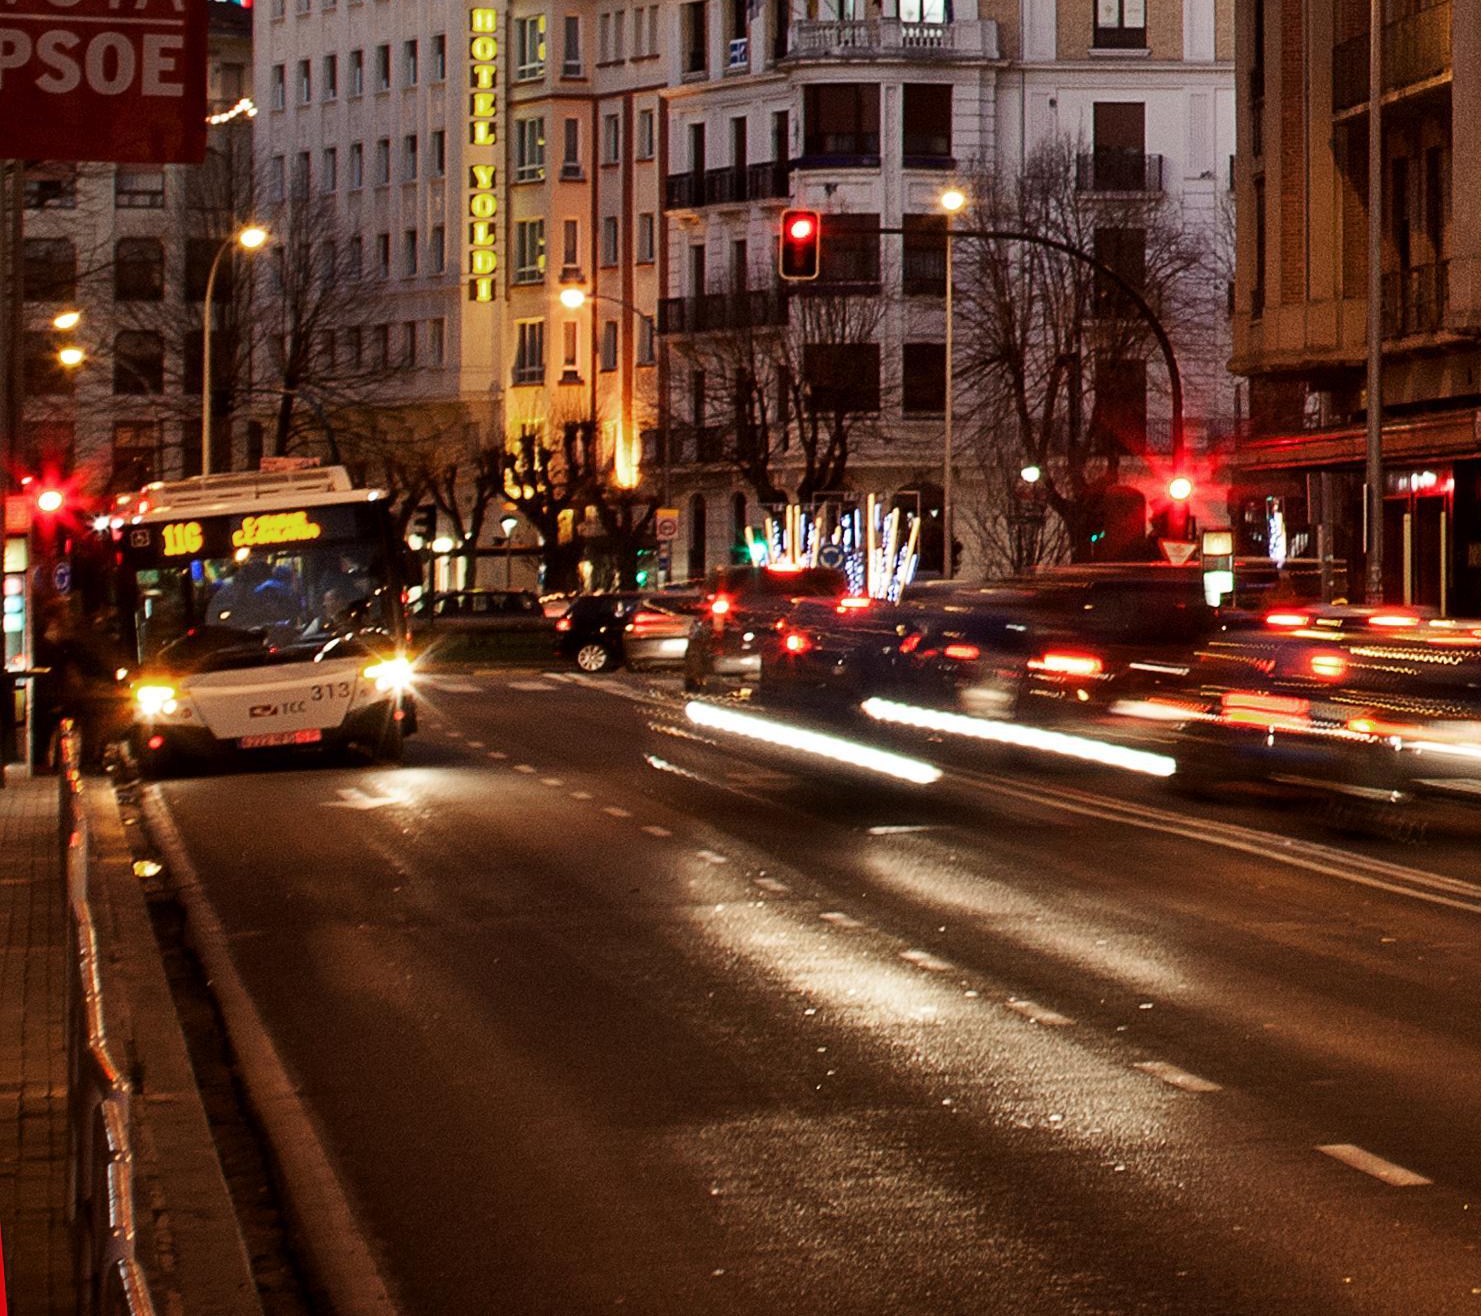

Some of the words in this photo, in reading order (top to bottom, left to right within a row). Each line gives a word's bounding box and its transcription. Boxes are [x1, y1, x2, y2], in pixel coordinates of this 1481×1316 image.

[0, 28, 185, 96] PSOE
[471, 8, 496, 145] HOTEL
[471, 165, 497, 302] YOLDI
[310, 682, 349, 701] 313
